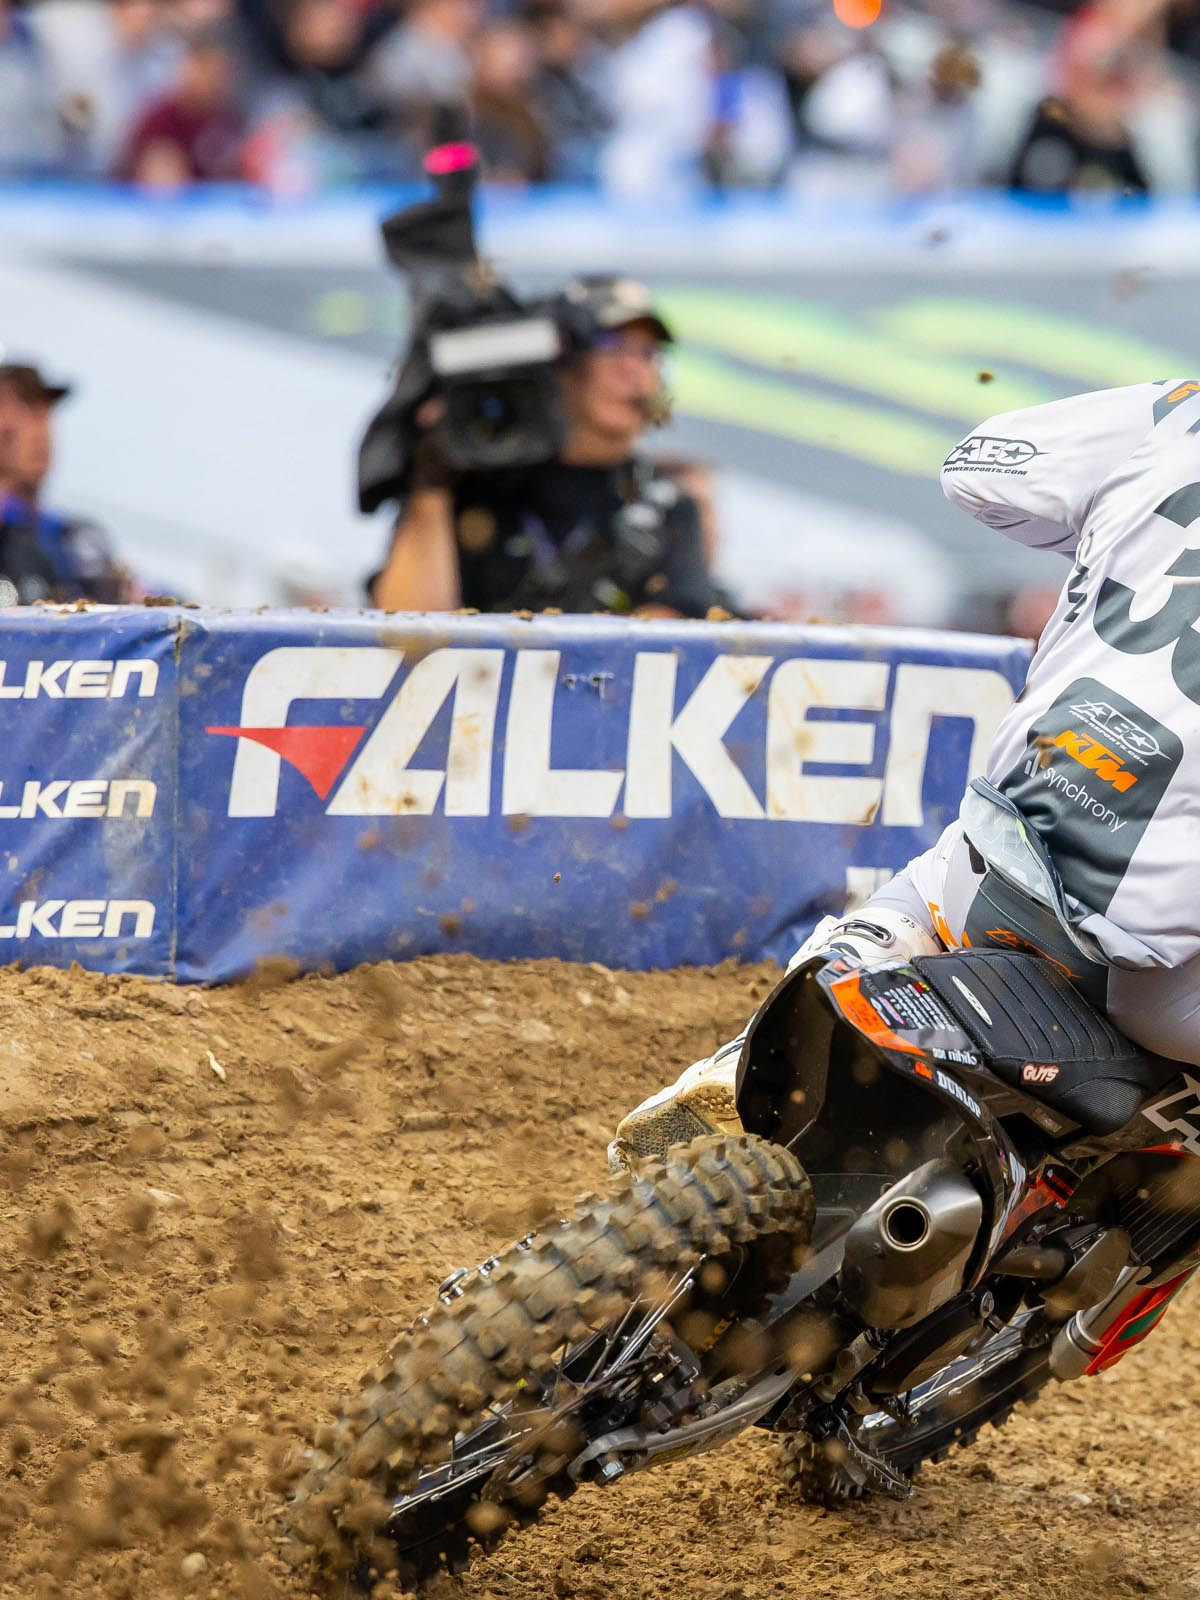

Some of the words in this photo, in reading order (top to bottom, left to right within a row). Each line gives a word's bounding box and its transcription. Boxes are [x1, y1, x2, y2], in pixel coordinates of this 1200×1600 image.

[943, 466, 1028, 476] POWERSPORTS.COM
[226, 646, 1018, 828] FALKEN
[1054, 730, 1138, 793] KTM
[1043, 766, 1127, 833] synchrony
[0, 899, 156, 938] KEN
[936, 1070, 981, 1118] DUNLOP
[1022, 1063, 1060, 1084] GUTS
